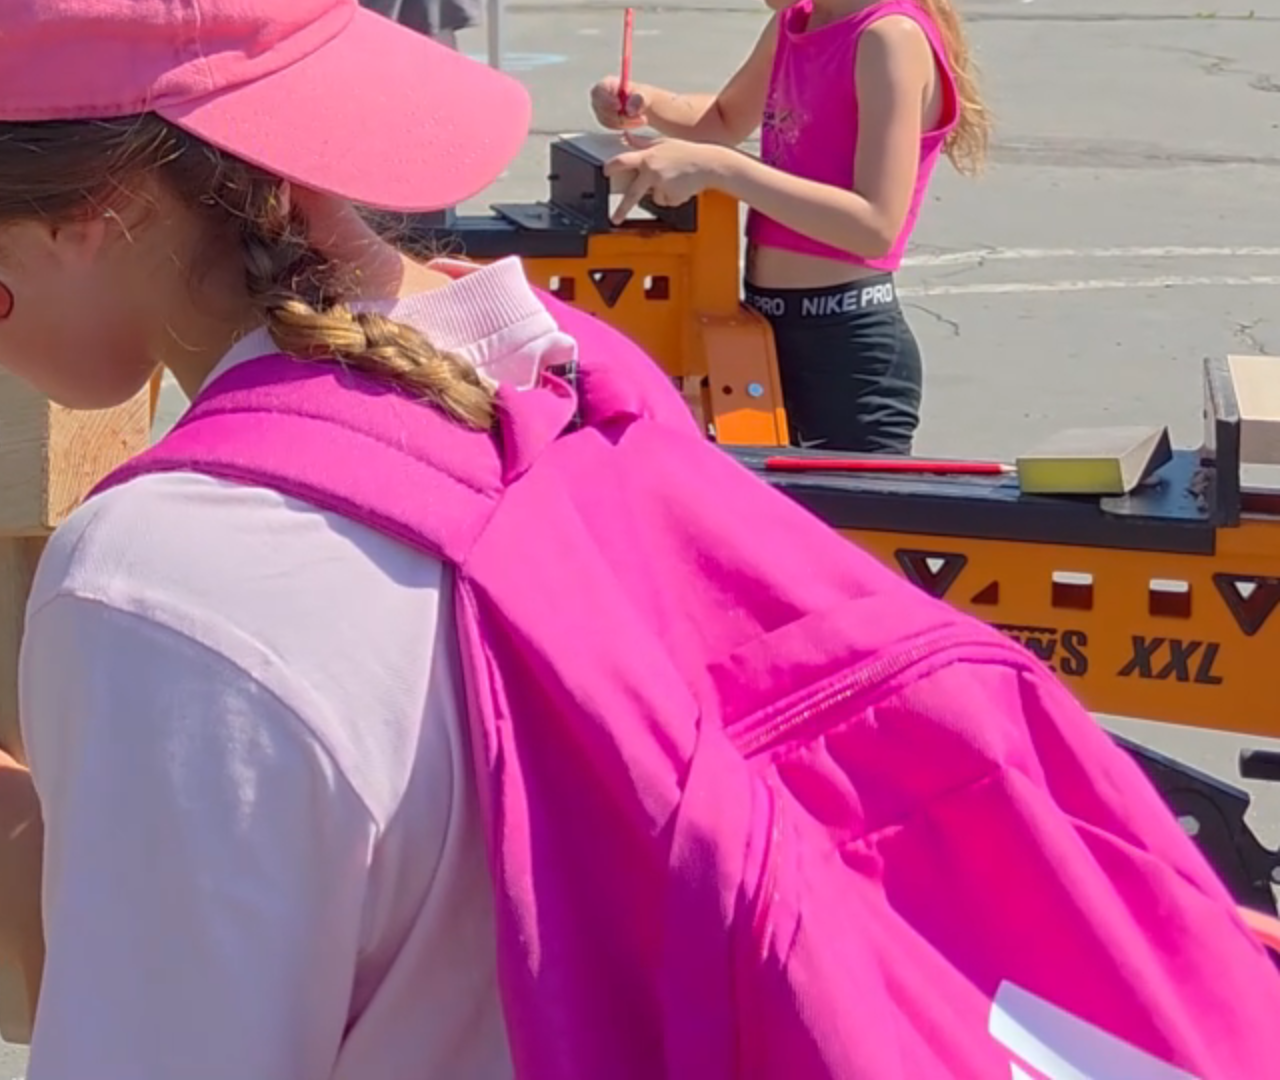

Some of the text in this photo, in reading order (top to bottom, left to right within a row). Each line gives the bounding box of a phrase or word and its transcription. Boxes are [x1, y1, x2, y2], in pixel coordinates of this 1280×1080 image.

[801, 290, 858, 316] NIKE
[861, 283, 893, 307] PRO
[1116, 634, 1224, 685] XXL
